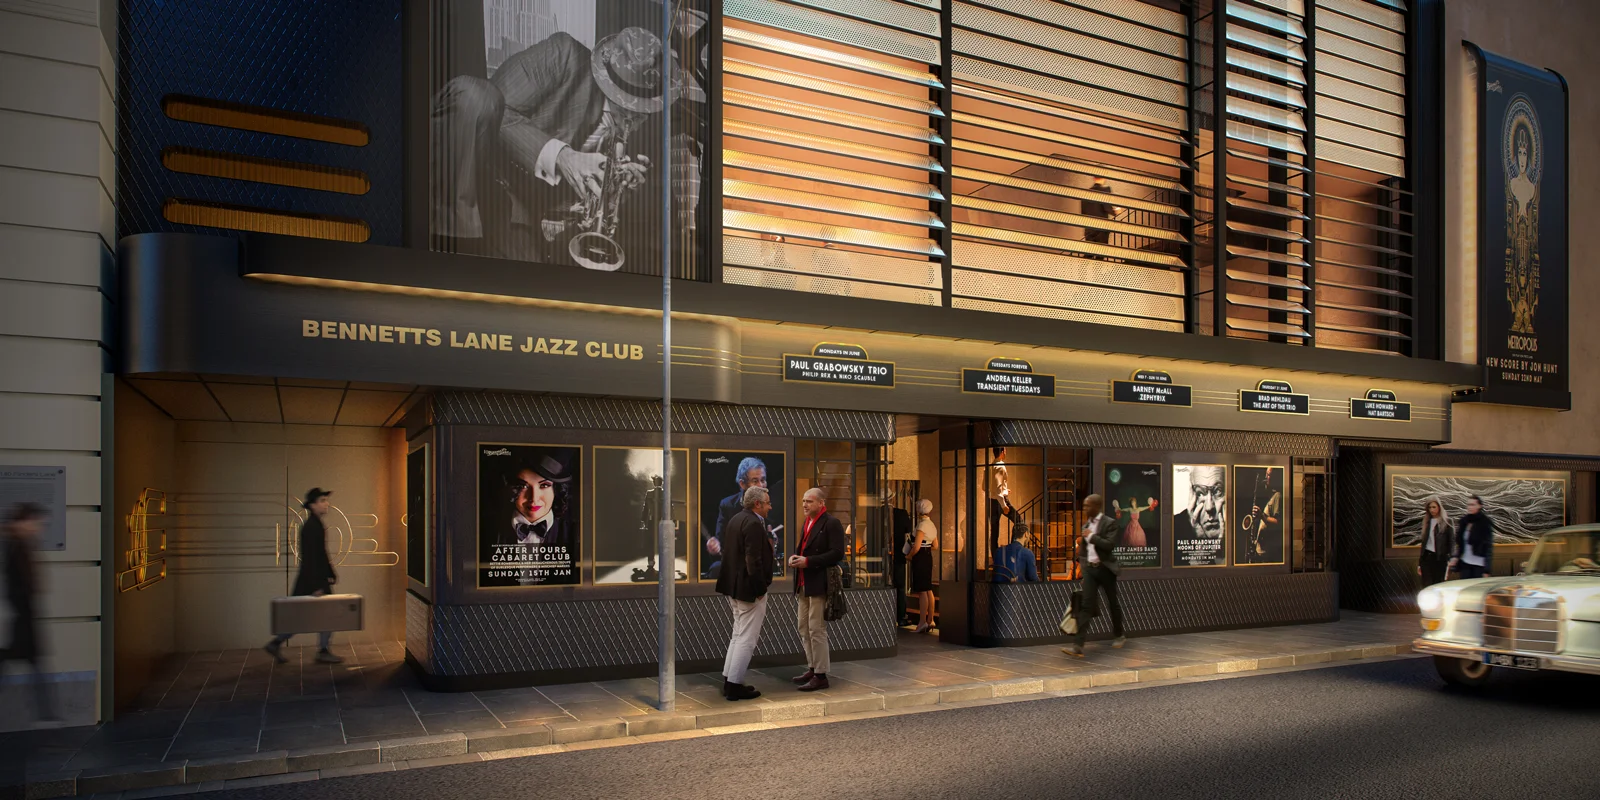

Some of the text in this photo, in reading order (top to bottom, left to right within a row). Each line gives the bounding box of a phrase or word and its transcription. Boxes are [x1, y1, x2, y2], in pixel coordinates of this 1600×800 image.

[302, 319, 644, 361] BENNETTS LANE JAZZ CLUB
[790, 359, 888, 376] PAUL GRABOWSKY TRIO
[1485, 356, 1499, 367] NEW
[1500, 358, 1519, 370] SCORE
[1521, 360, 1529, 370] BY
[1530, 361, 1542, 372] JON
[1543, 363, 1558, 374] HUNT
[986, 374, 1032, 385] ANDREA KELLER
[1502, 371, 1520, 382] SUNDAY
[1533, 375, 1543, 383] MAY
[977, 382, 1040, 394] TRANSIENT TUESDAYS
[1132, 385, 1173, 395] BARNEY McALL
[1139, 393, 1166, 402] ZEPHYRIX
[1271, 395, 1292, 403] MEHLDAU
[532, 546, 567, 554] HOURS
[492, 553, 571, 562] CABARET CLUB
[488, 570, 525, 578] SUNDAY
[529, 569, 550, 577] 15TH
